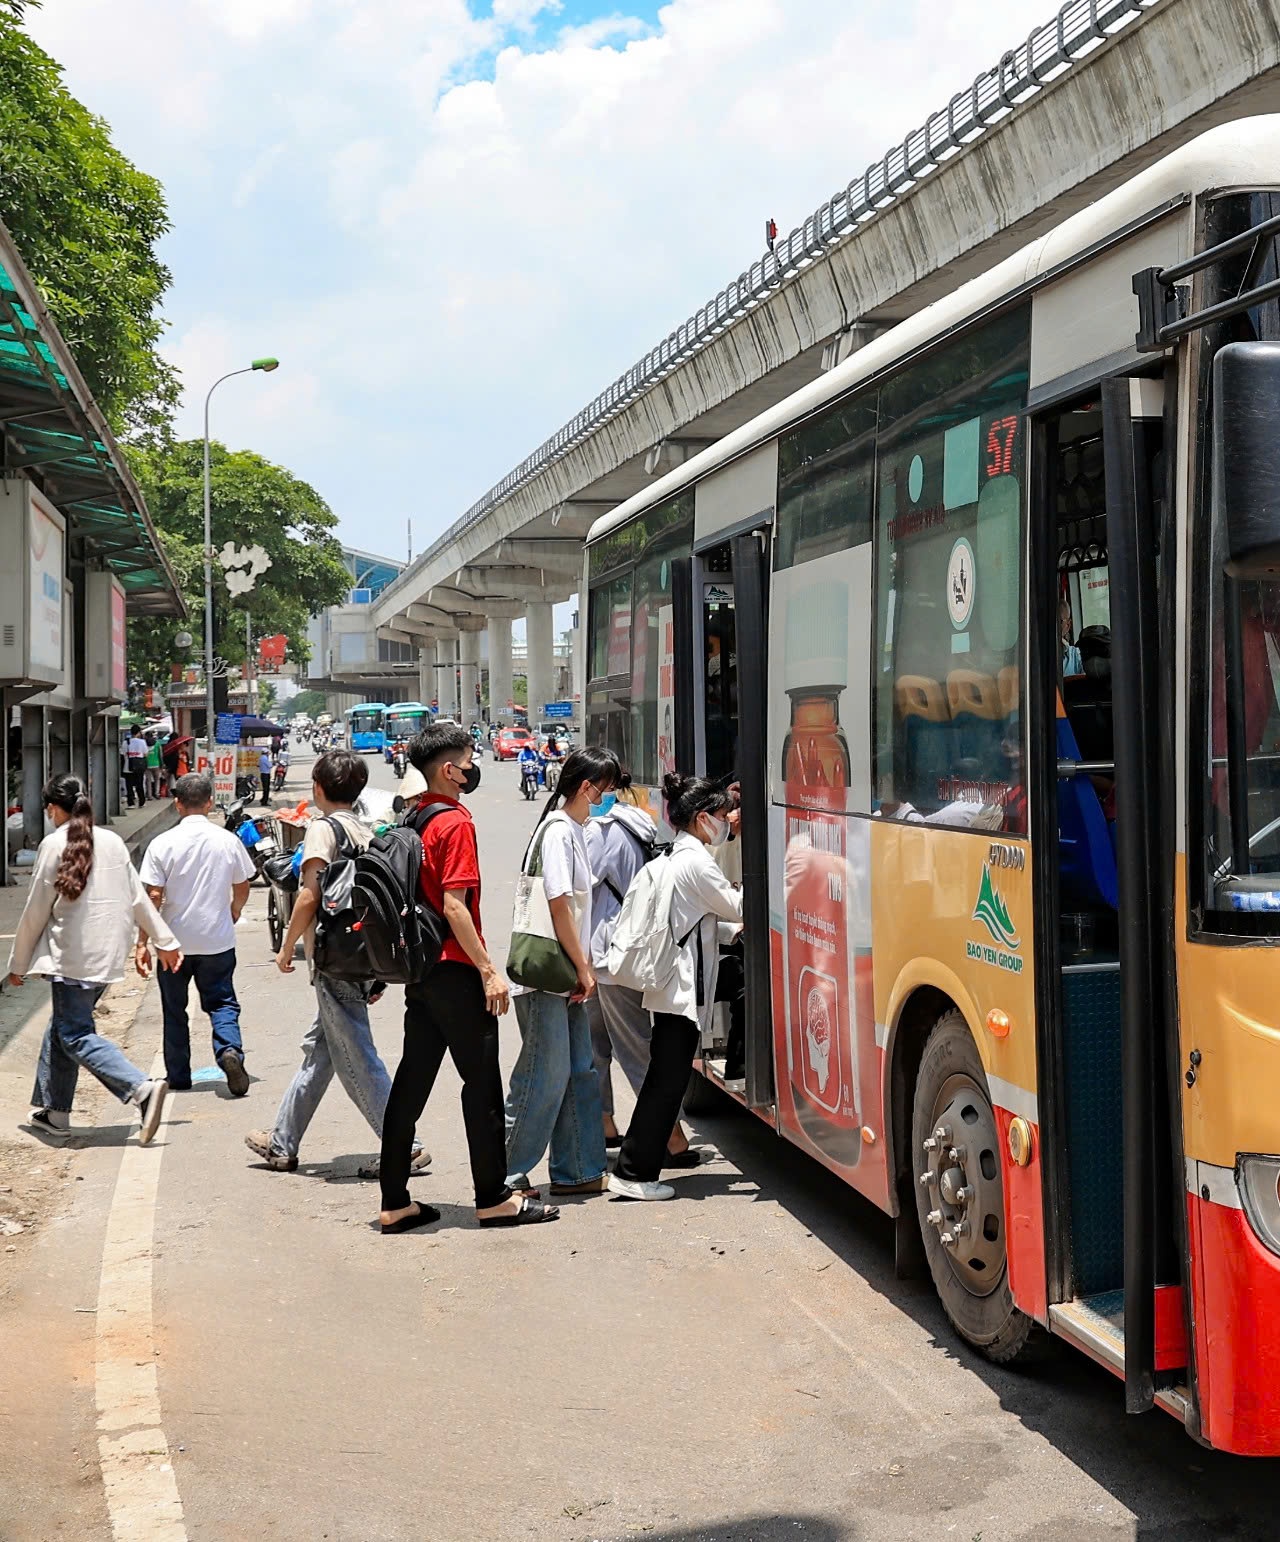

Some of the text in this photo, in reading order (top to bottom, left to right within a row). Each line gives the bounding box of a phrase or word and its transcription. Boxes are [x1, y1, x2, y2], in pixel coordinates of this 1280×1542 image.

[987, 415, 1017, 476] 57
[967, 942, 1023, 973] BAO YEN GROUP
